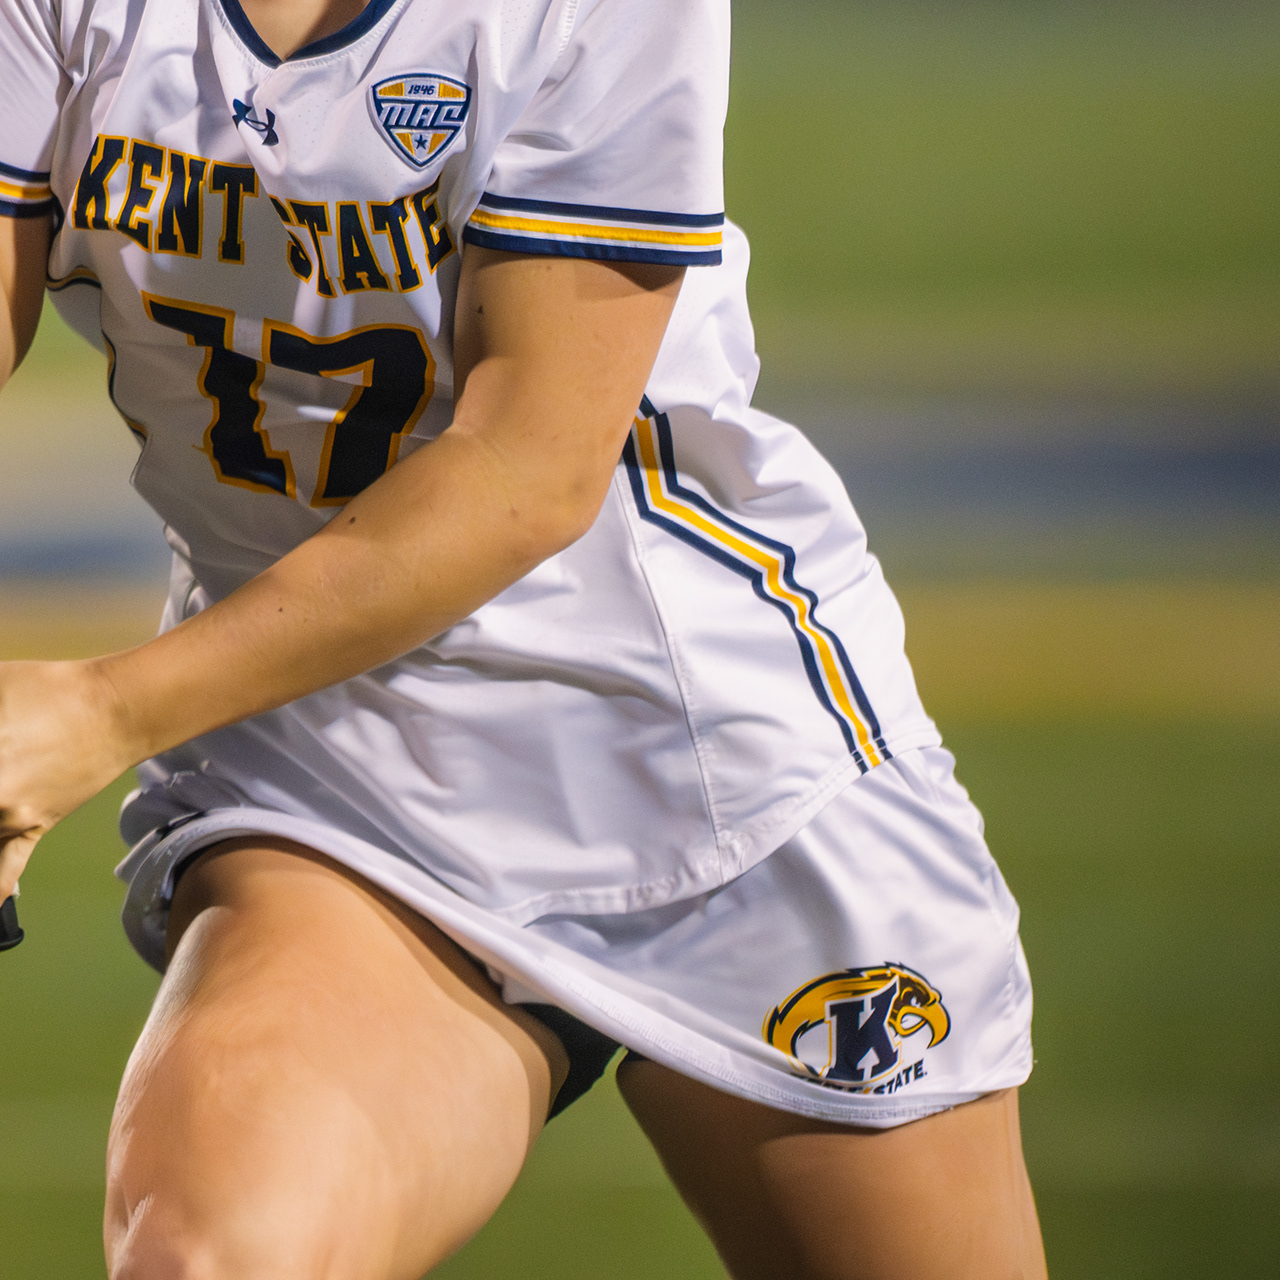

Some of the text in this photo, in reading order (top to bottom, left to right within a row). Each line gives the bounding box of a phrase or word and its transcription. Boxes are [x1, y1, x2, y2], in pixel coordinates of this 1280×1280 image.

[379, 102, 464, 127] MAC
[407, 84, 436, 96] 1946
[72, 134, 260, 265] KENT
[268, 175, 458, 299] STATE
[142, 290, 437, 508] 17
[824, 977, 900, 1082] K
